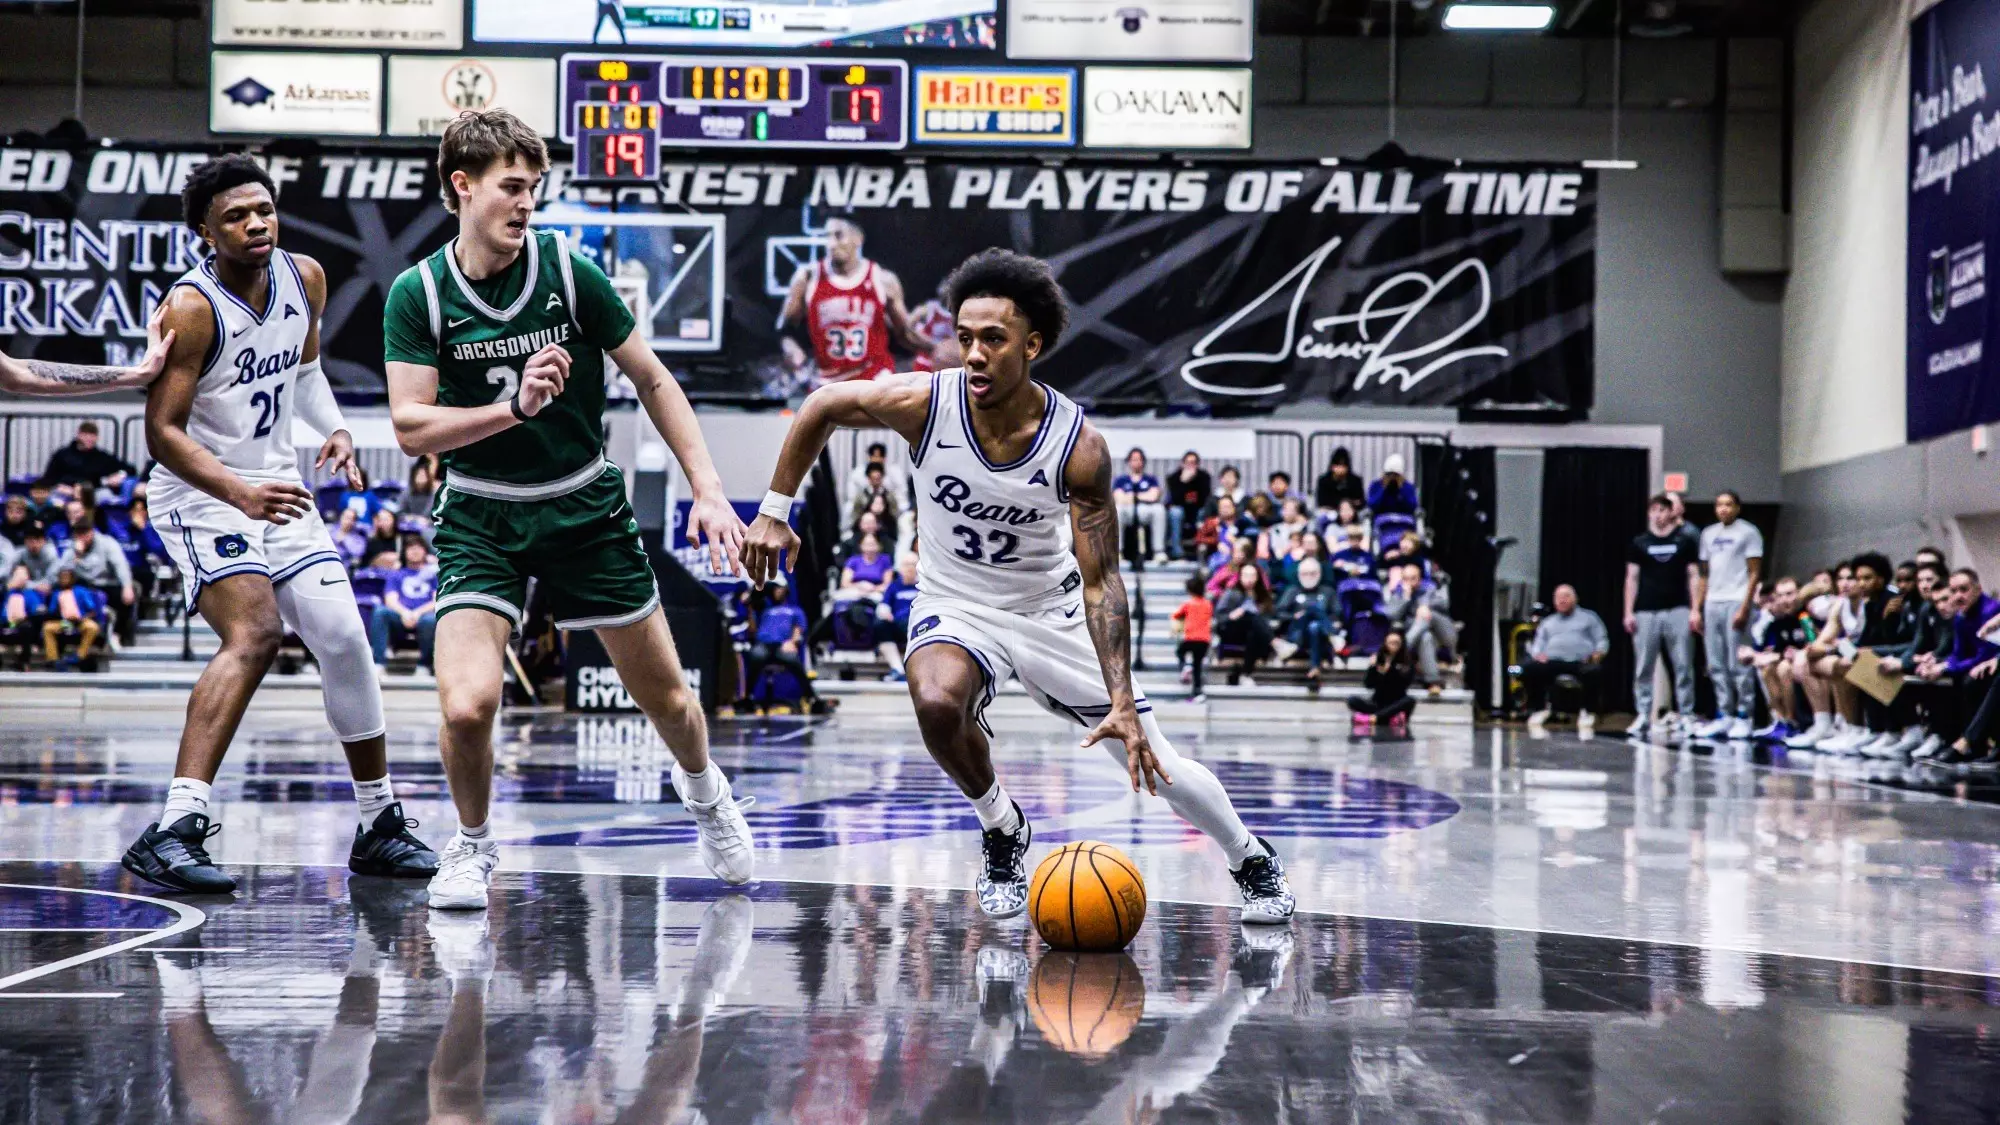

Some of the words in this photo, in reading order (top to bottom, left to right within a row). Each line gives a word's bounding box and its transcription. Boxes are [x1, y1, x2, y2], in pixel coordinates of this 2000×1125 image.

[284, 83, 370, 102] Arkansas
[692, 66, 790, 101] 11:01
[927, 80, 1061, 106] Halter's
[1094, 89, 1243, 115] OAKLAWN
[851, 89, 881, 124] 17
[926, 111, 990, 131] BODY
[996, 111, 1062, 132] SHOP
[605, 134, 644, 178] 19
[86, 151, 209, 194] ONE
[320, 157, 429, 200] THE
[808, 167, 931, 208] NBA
[949, 169, 1210, 212] PLAYERS
[1223, 171, 1304, 213] OF
[1311, 171, 1421, 214] ALL
[1442, 173, 1583, 216] TIME
[0, 210, 207, 272] CENTR
[453, 322, 570, 361] JACKSONVILLE
[825, 327, 868, 362] 33
[229, 344, 301, 388] Bears
[929, 474, 1045, 526] Bears
[952, 524, 1022, 564] 32
